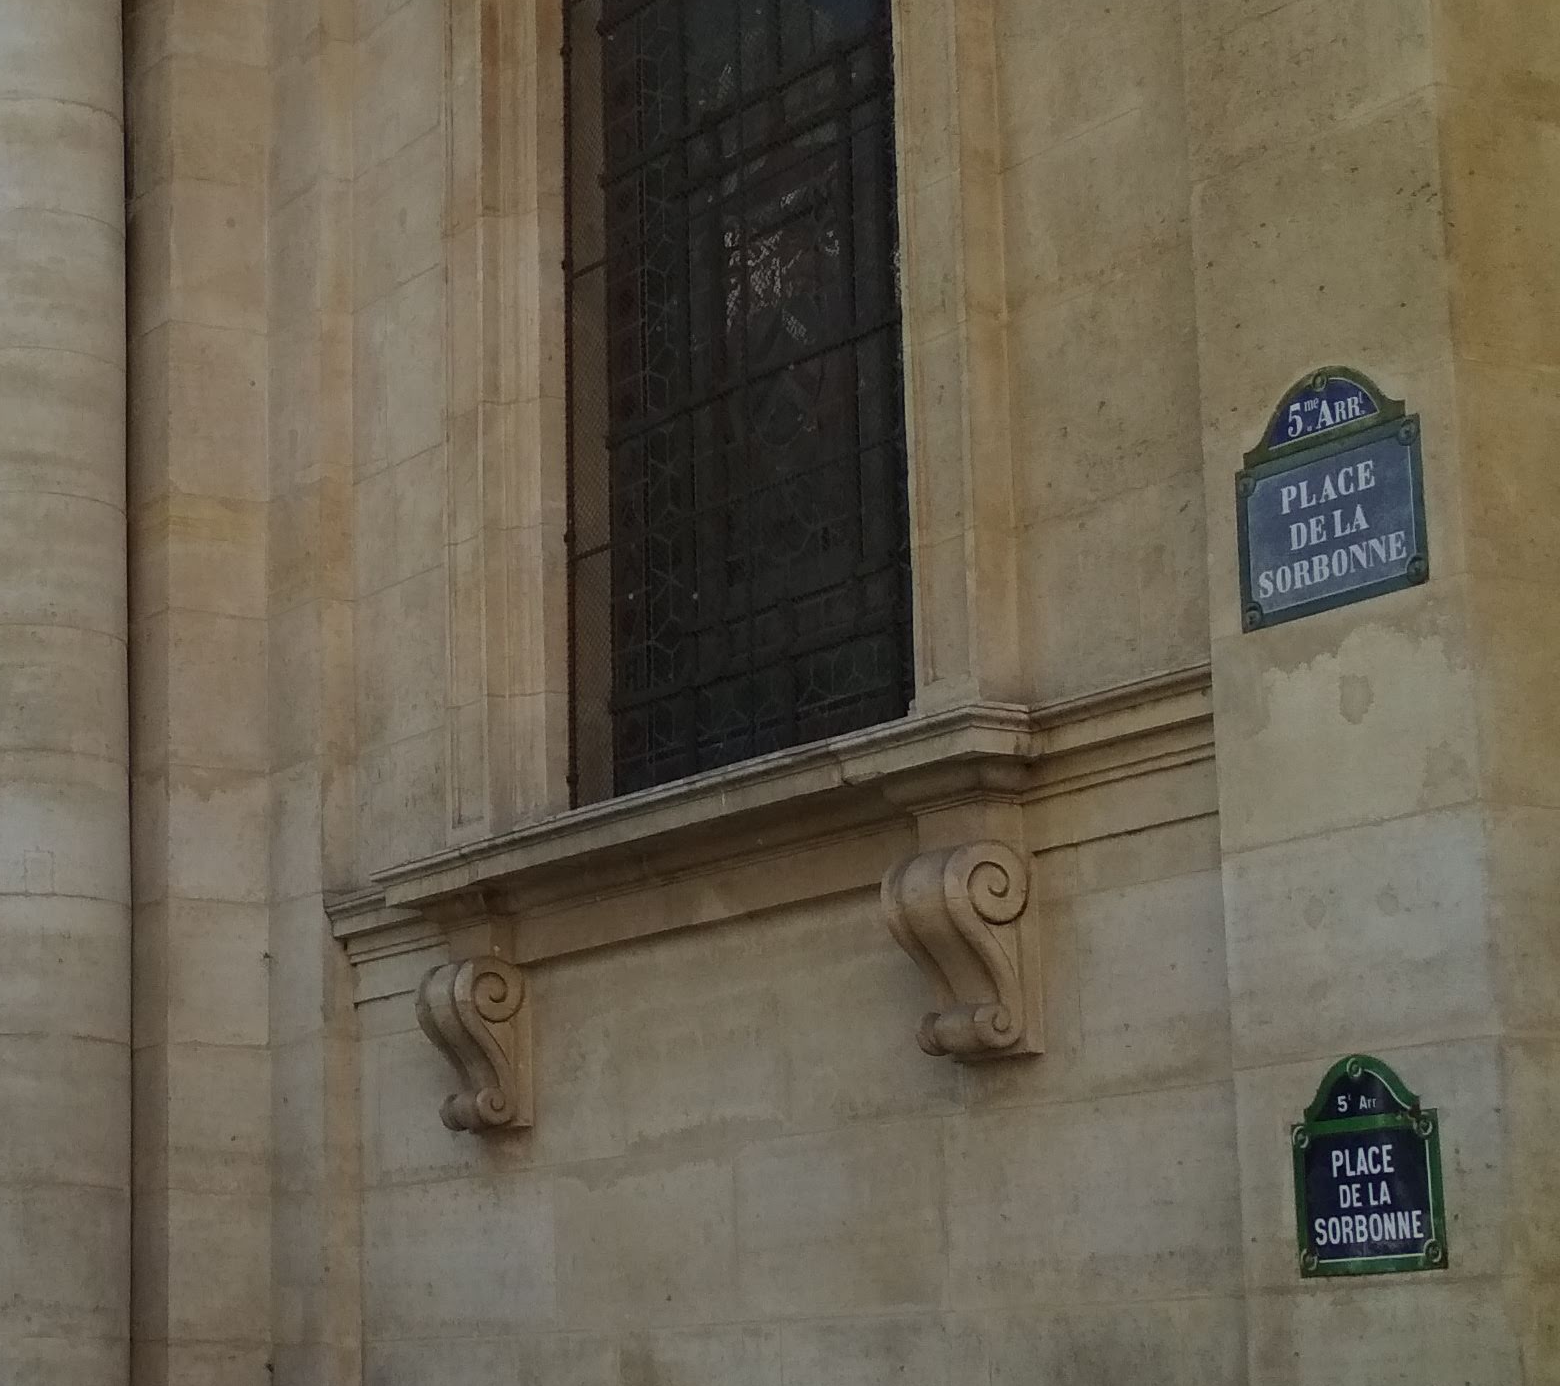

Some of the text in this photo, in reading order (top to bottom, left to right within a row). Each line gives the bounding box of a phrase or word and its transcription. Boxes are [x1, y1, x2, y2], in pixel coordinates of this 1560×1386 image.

[1280, 460, 1376, 515] PLACE
[1290, 503, 1370, 551] DE LA
[1258, 530, 1407, 599] SORBONNE
[1359, 1094, 1377, 1110] Arr
[1331, 1144, 1395, 1178] PLACE
[1339, 1180, 1392, 1209] DE LA
[1314, 1210, 1425, 1246] SORBONNE
